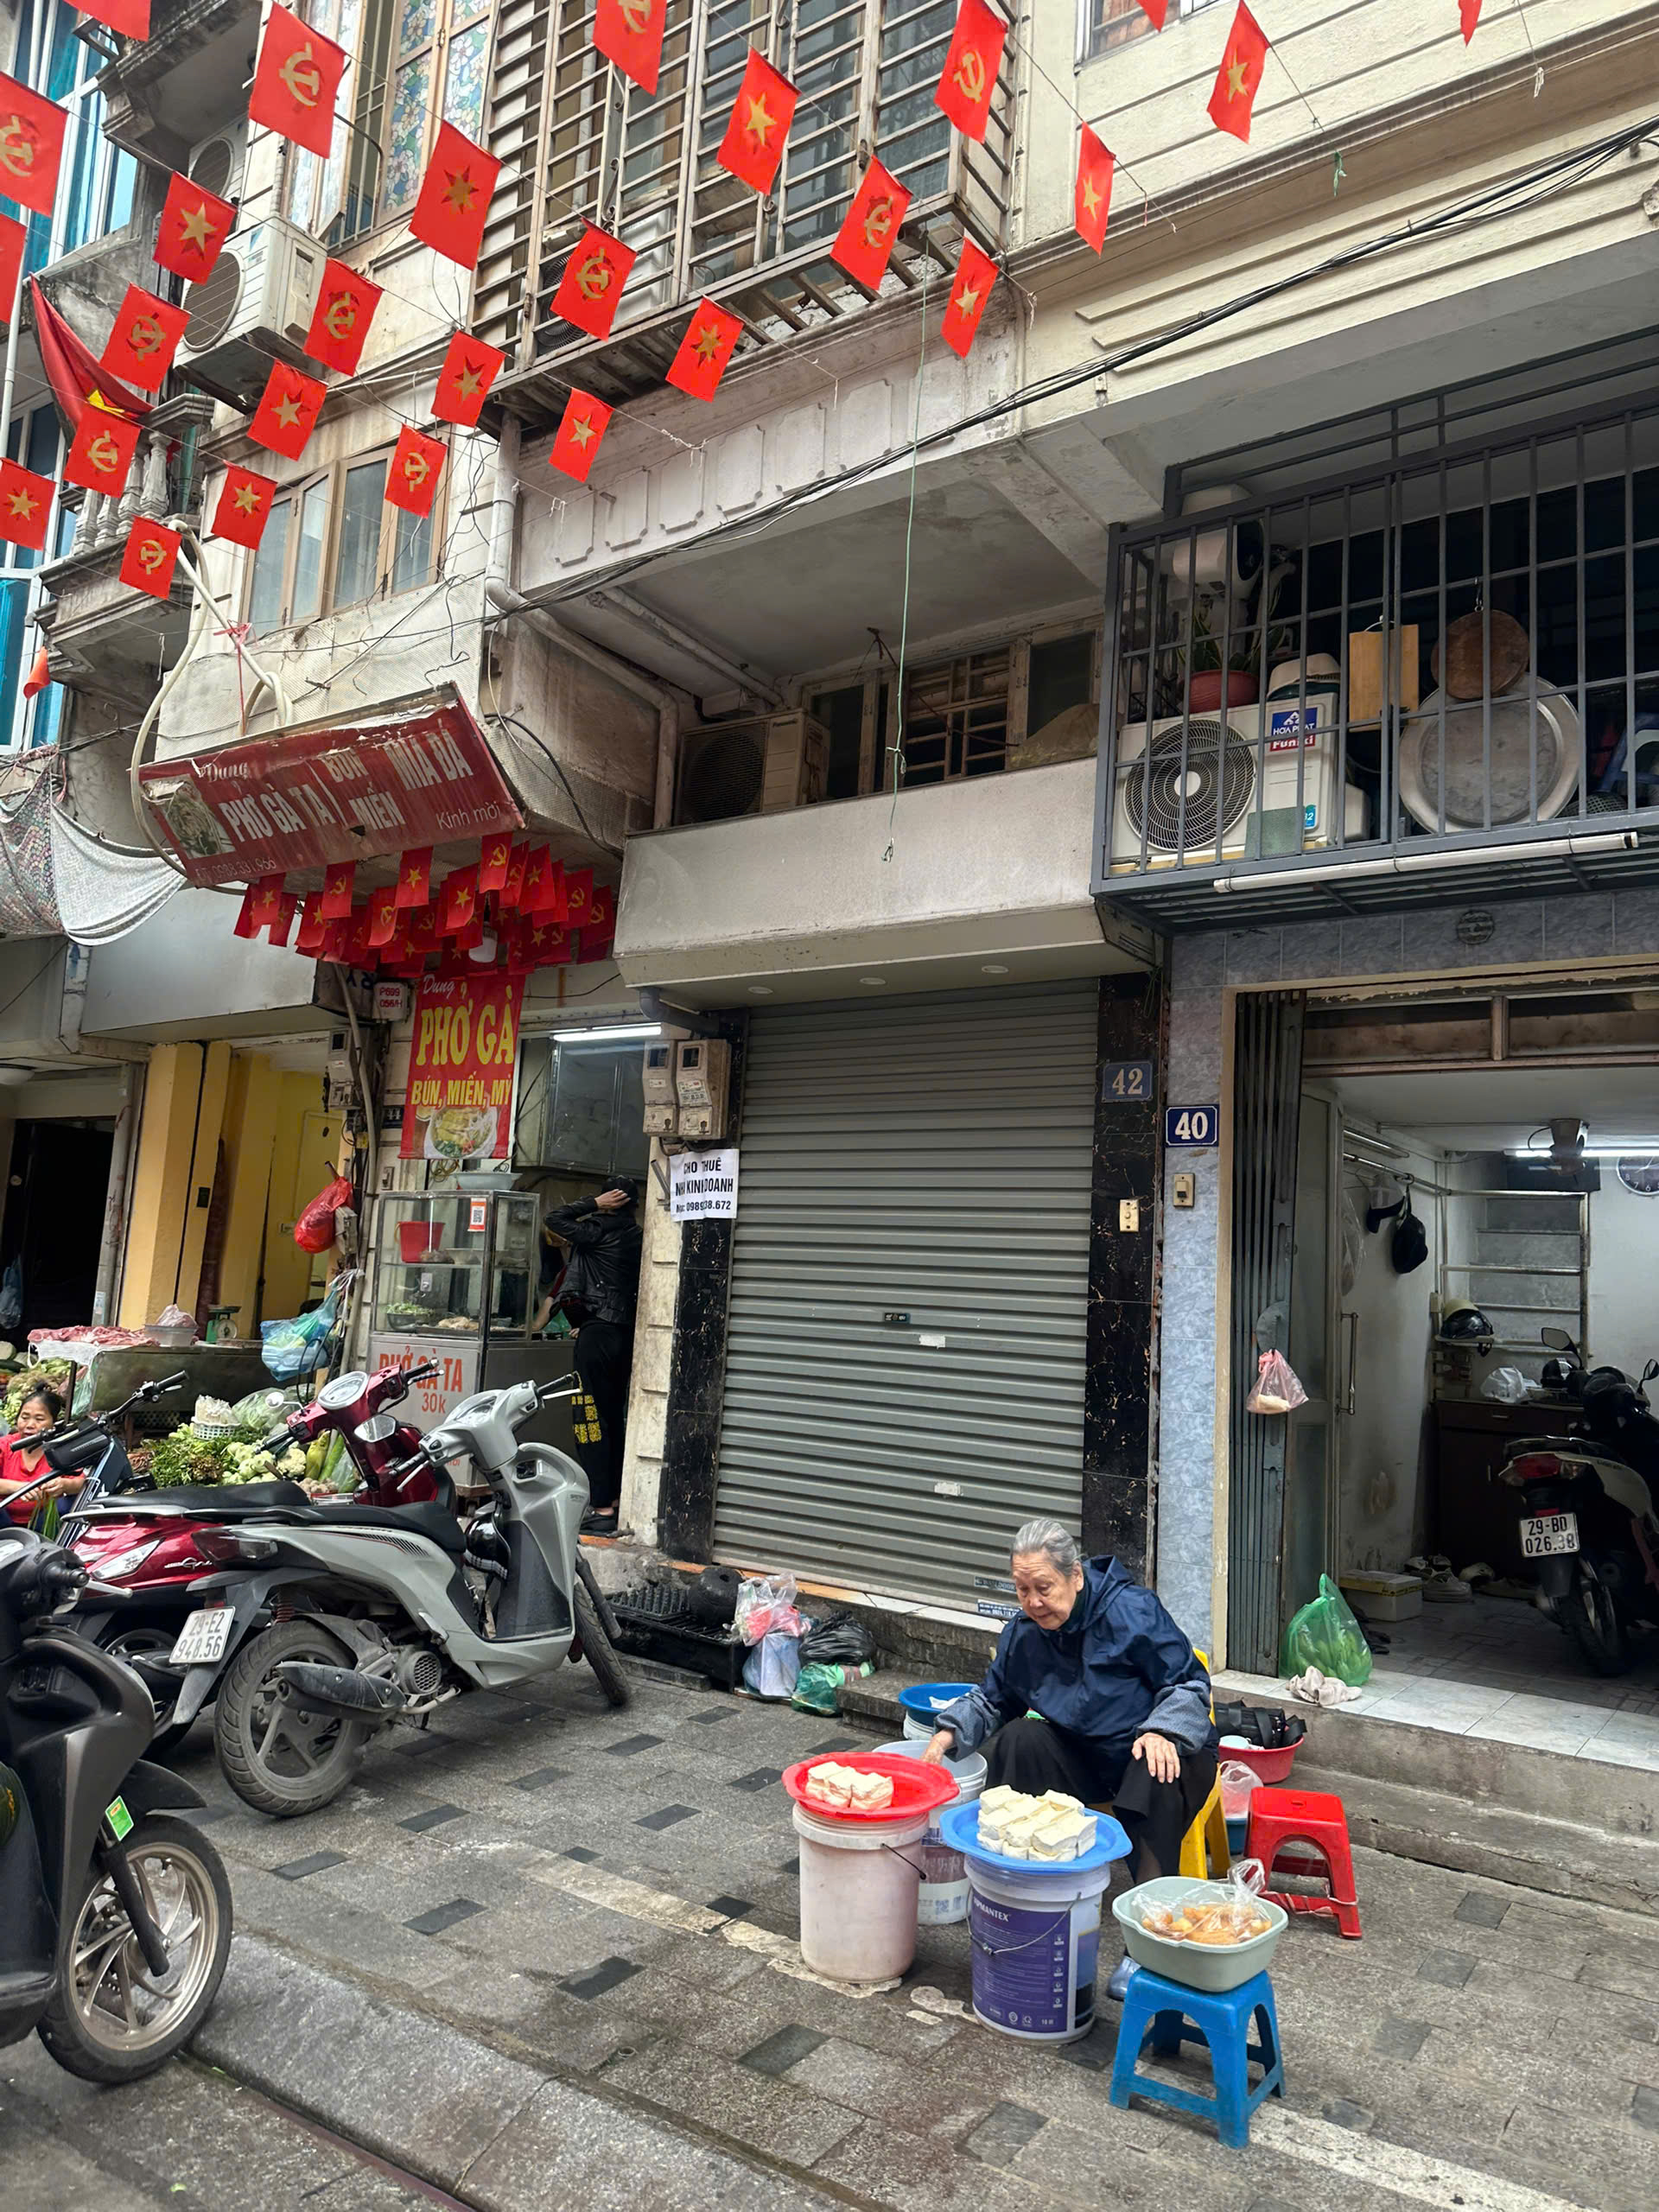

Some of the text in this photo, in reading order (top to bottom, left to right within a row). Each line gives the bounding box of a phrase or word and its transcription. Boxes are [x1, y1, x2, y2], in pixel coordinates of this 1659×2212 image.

[219, 781, 336, 842] PHỞ GÀ TA
[348, 781, 405, 830] MIẾN
[423, 974, 455, 1000] Dung
[416, 982, 514, 1065] PHỞ GÀ
[410, 1075, 443, 1108] BÚN,
[447, 1071, 487, 1109] MIẾN,
[1112, 1068, 1143, 1096] 42
[386, 1109, 401, 1120] 44
[1175, 1111, 1209, 1141] 40
[683, 1157, 721, 1175] CHO THUÊ
[443, 1357, 462, 1393] TA
[1528, 1516, 1567, 1535] 29-BD
[1525, 1533, 1575, 1554] 026.38
[188, 1611, 226, 1637] 29-E2
[175, 1636, 223, 1659] 948.56
